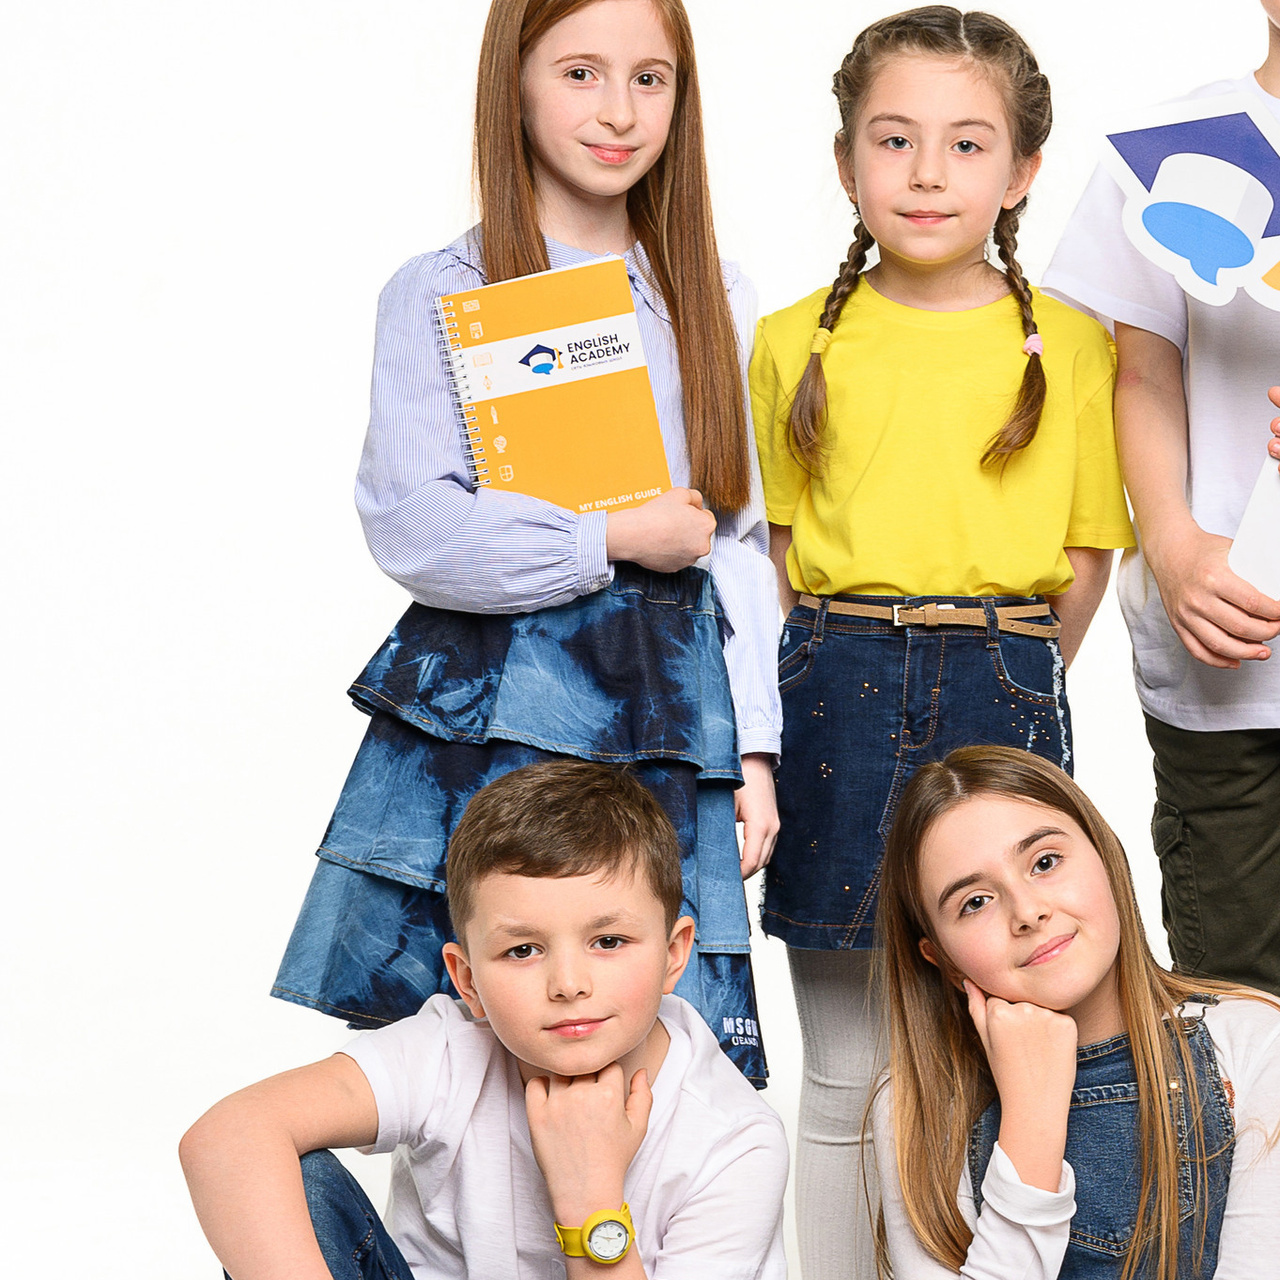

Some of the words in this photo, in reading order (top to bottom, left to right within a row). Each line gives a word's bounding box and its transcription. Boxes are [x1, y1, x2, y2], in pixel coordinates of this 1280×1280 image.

[567, 333, 618, 353] ENGLISH
[570, 342, 630, 365] ACADEMY
[579, 502, 593, 511] MY
[595, 494, 633, 509] ENGLISH
[634, 487, 662, 500] GUIDE
